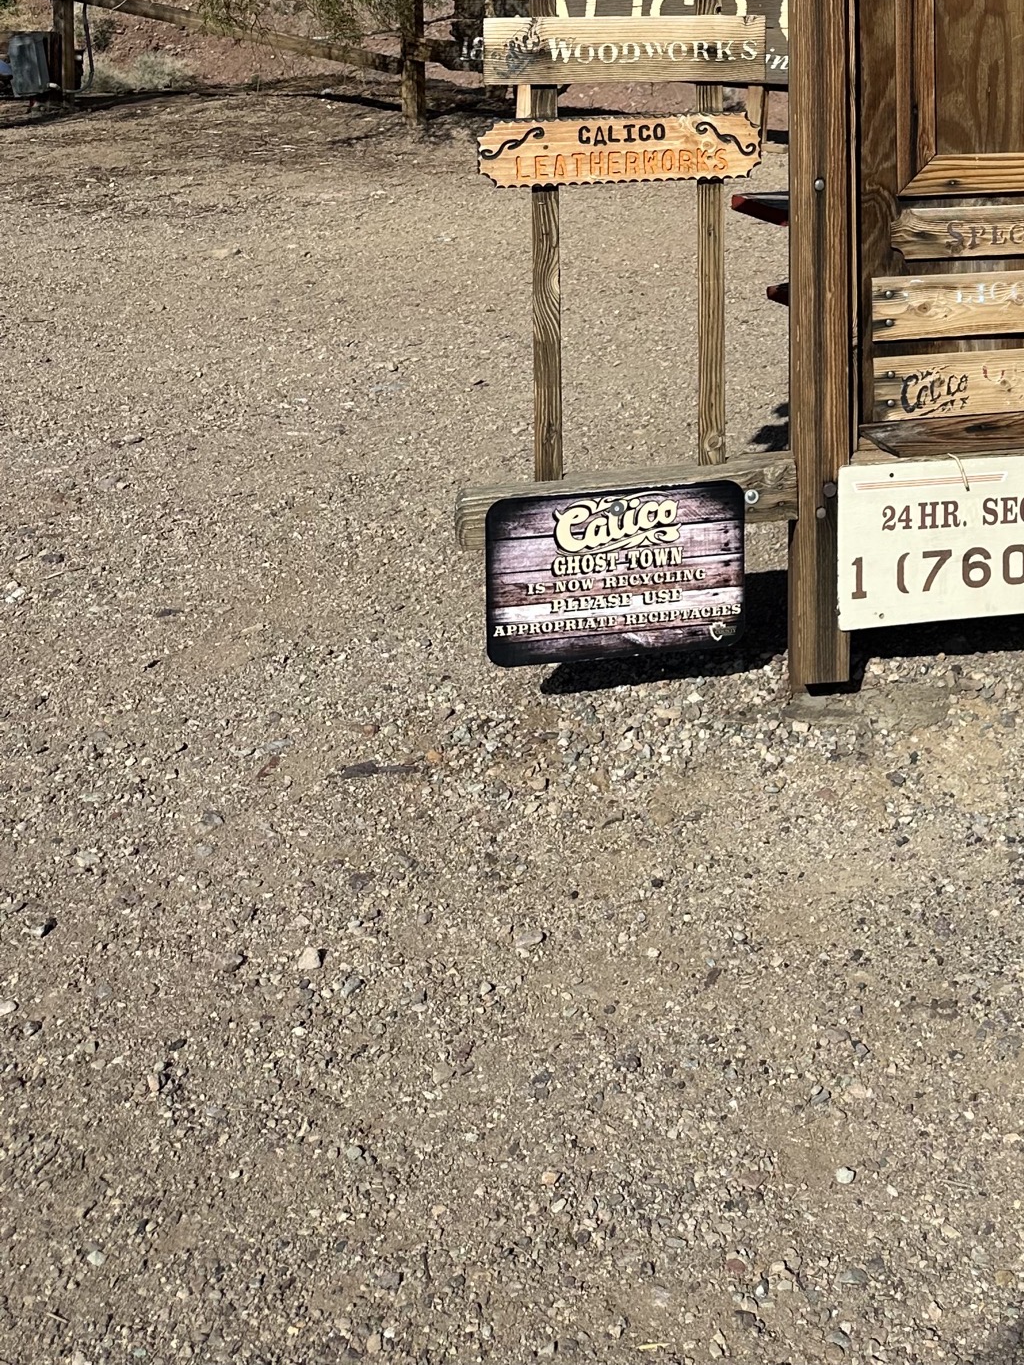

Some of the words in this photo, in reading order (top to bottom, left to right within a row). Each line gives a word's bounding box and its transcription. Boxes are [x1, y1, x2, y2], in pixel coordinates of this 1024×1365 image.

[548, 37, 757, 65] WOODWORKS
[578, 123, 666, 146] CALICO
[514, 148, 730, 181] LEATHERWORKS
[554, 496, 680, 553] Calico
[552, 552, 620, 577] GHOST
[627, 547, 683, 569] TOWN
[527, 582, 546, 596] IS
[554, 579, 596, 593] NOW
[604, 568, 707, 589] RECYCLING
[850, 556, 868, 600] 1
[551, 592, 634, 612] PLEASE
[643, 588, 684, 604] USE
[493, 616, 618, 638] APPROPRIATE
[625, 603, 742, 626] RECEPTACLES
